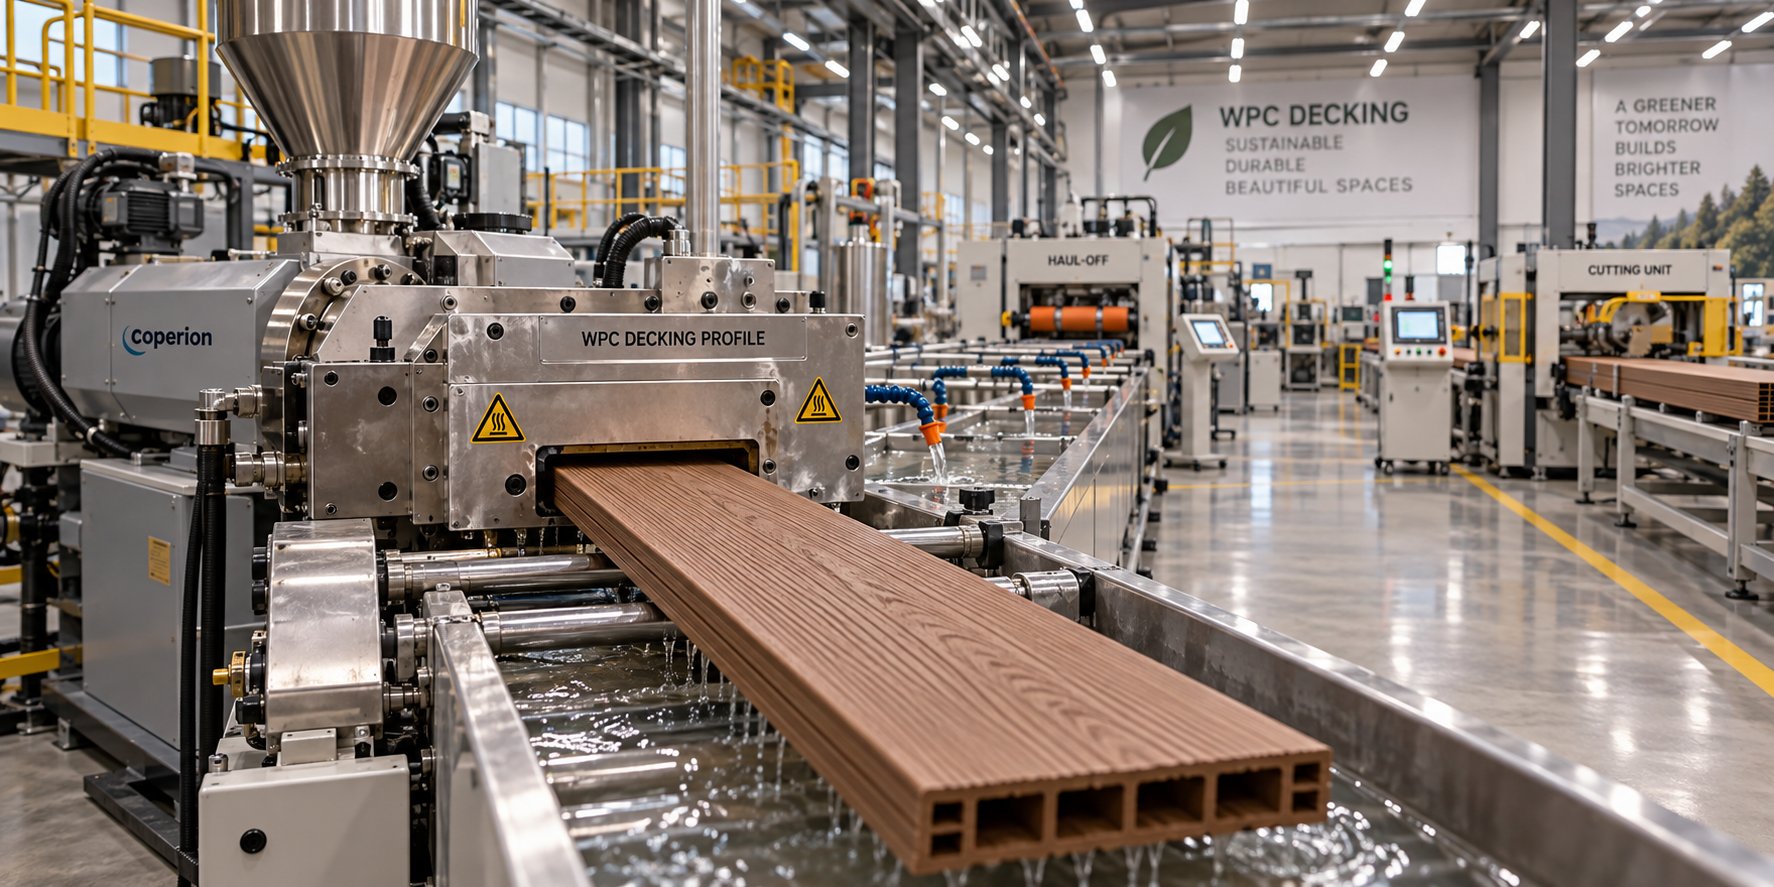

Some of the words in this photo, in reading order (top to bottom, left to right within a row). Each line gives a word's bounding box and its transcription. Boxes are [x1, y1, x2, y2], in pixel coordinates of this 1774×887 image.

[1615, 99, 1627, 113] A
[1633, 97, 1717, 113] GREENER
[1219, 105, 1280, 128] WPC
[1289, 101, 1409, 127] DECKING
[1615, 118, 1720, 134] TOMORROW
[1225, 134, 1343, 152] SUSTAINABLE
[1615, 140, 1677, 155] BUILDS
[1225, 157, 1306, 174] DURABLE
[1614, 160, 1701, 177] BRIGHTER
[1225, 178, 1328, 196] BEAUTIFUL
[1335, 176, 1414, 194] SPACES
[1614, 182, 1680, 198] SPACES
[1047, 254, 1109, 267] HAUL-OFF
[1587, 264, 1641, 276] CUTTING
[1643, 264, 1673, 276] UNIT
[581, 330, 620, 347] WPC
[624, 330, 697, 347] DECKING
[701, 330, 766, 346] PROFILE
